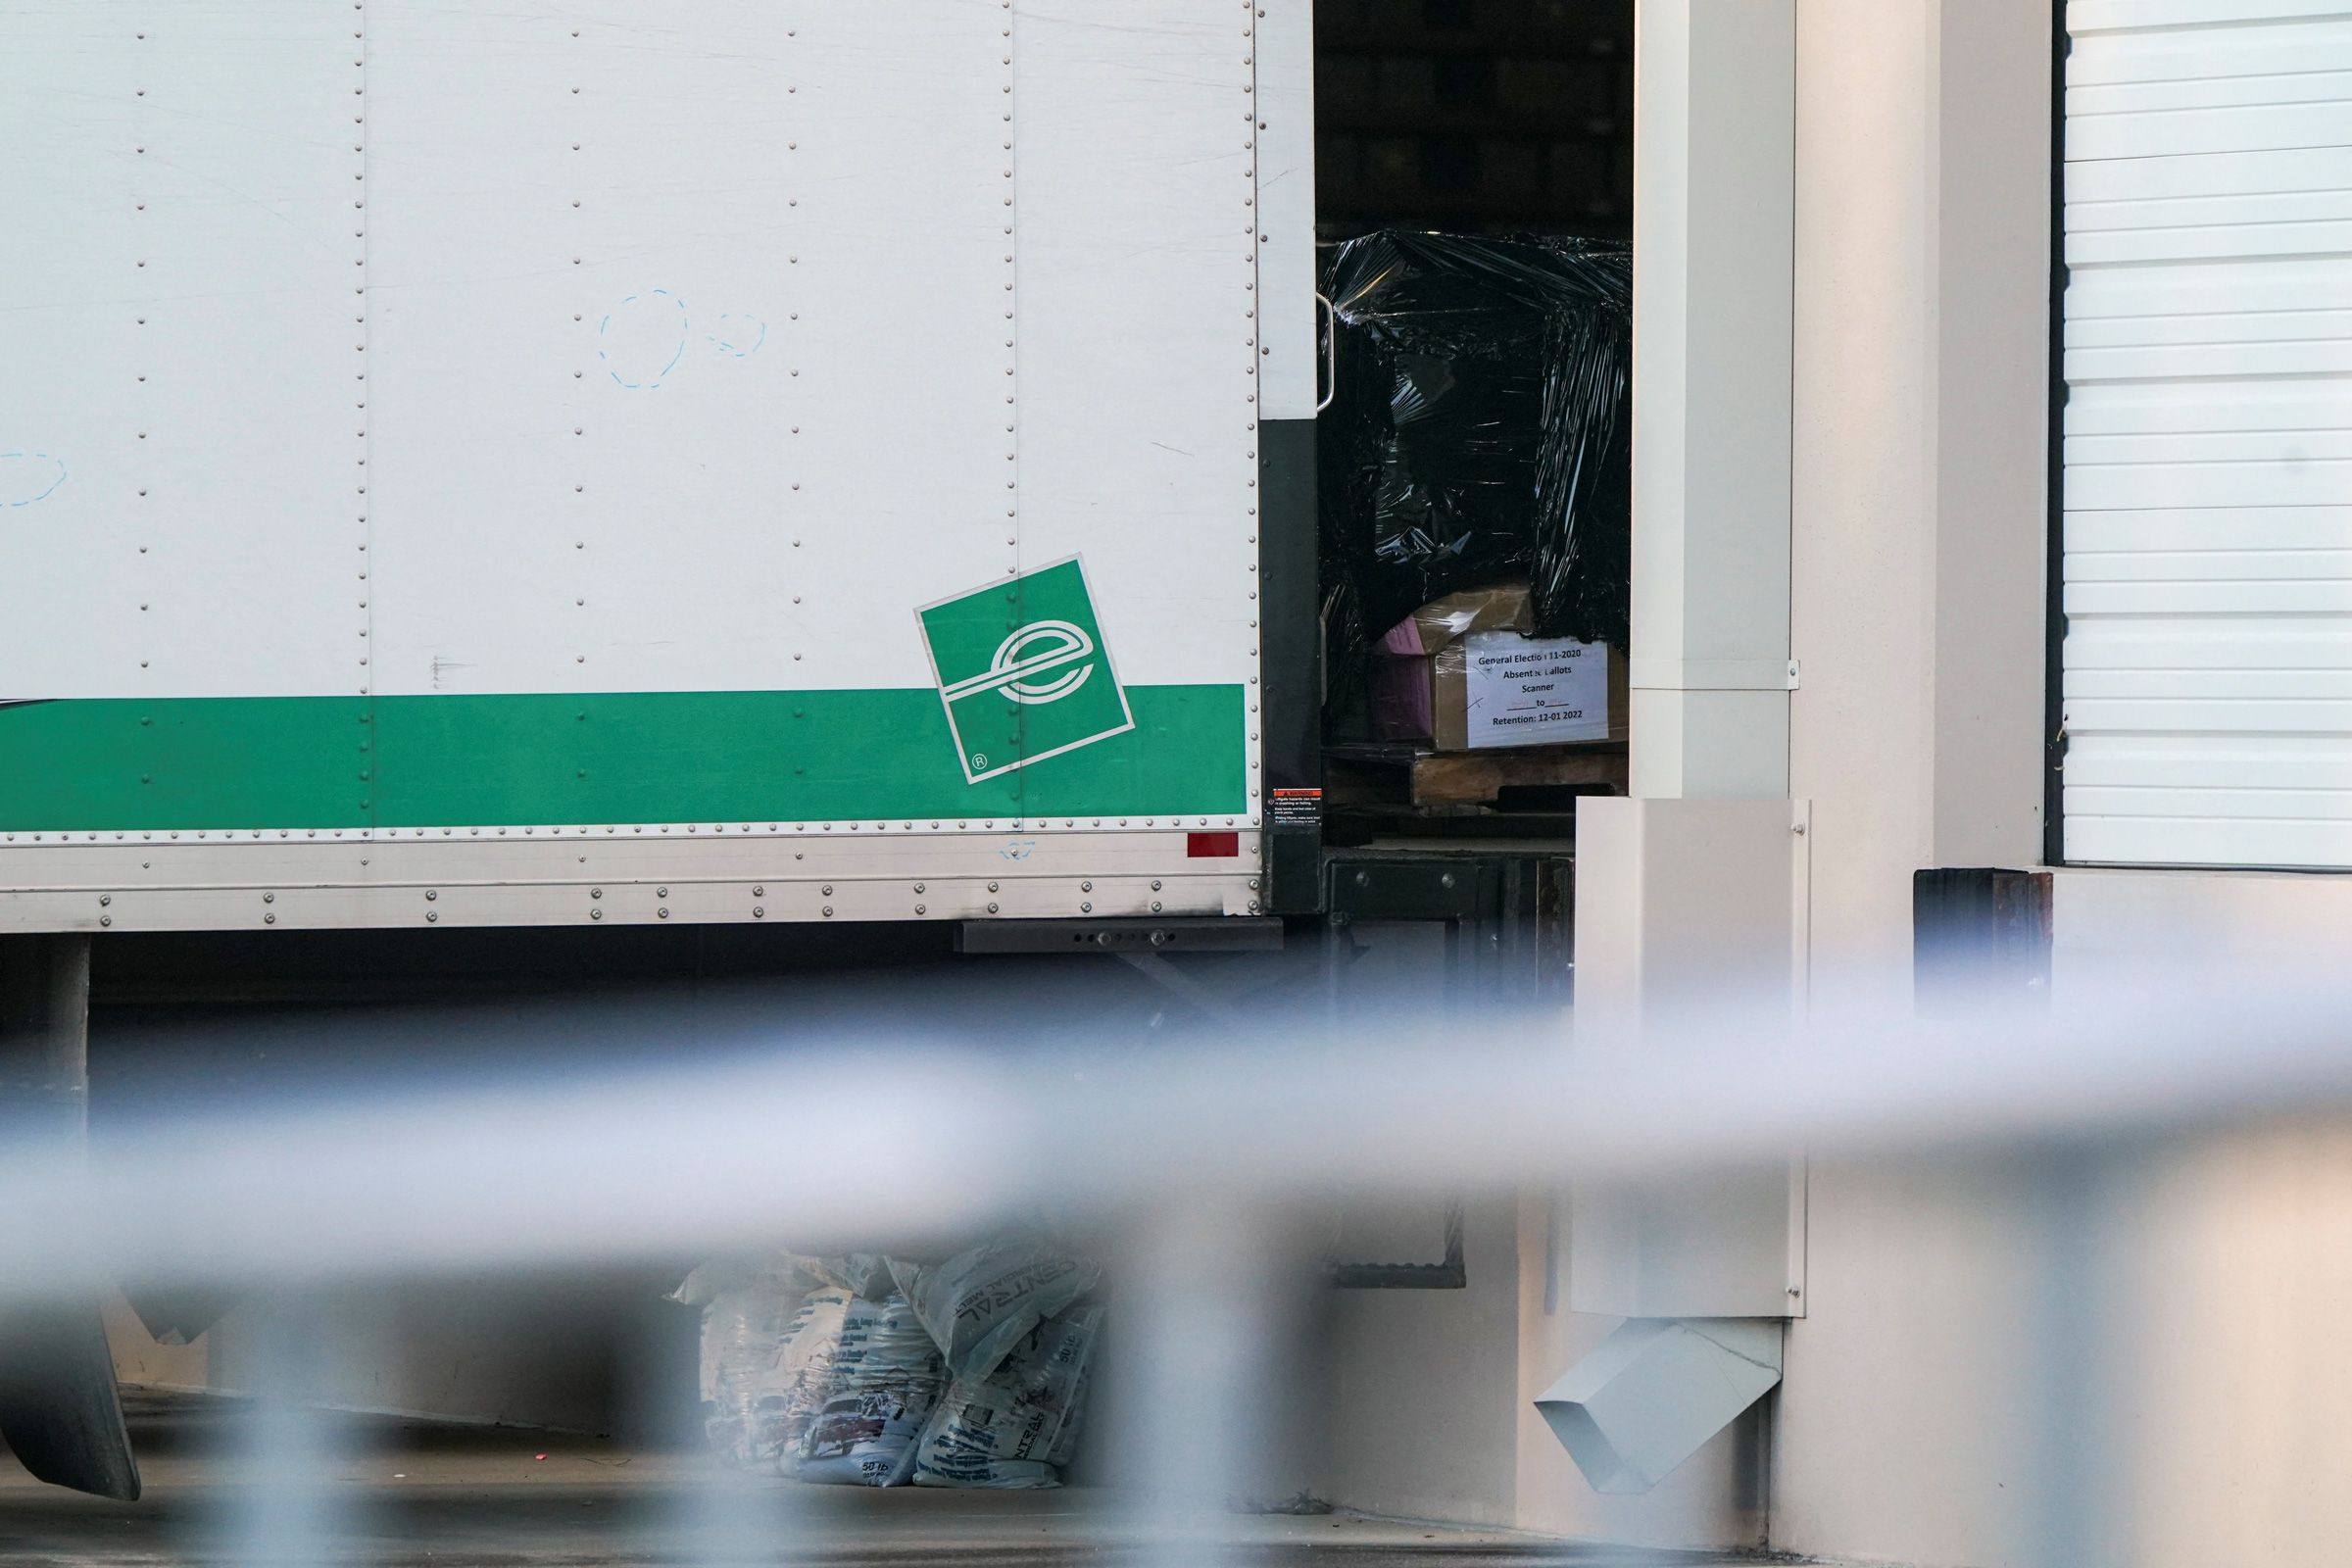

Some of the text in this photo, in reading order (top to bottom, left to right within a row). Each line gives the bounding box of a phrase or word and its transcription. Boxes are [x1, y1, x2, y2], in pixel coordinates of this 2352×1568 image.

[1478, 655, 1512, 665] General
[1544, 665, 1572, 676] allots
[1521, 683, 1554, 693] Scanner
[1493, 710, 1583, 726] Retention: 12-01 2022
[862, 1461, 875, 1471] 50
